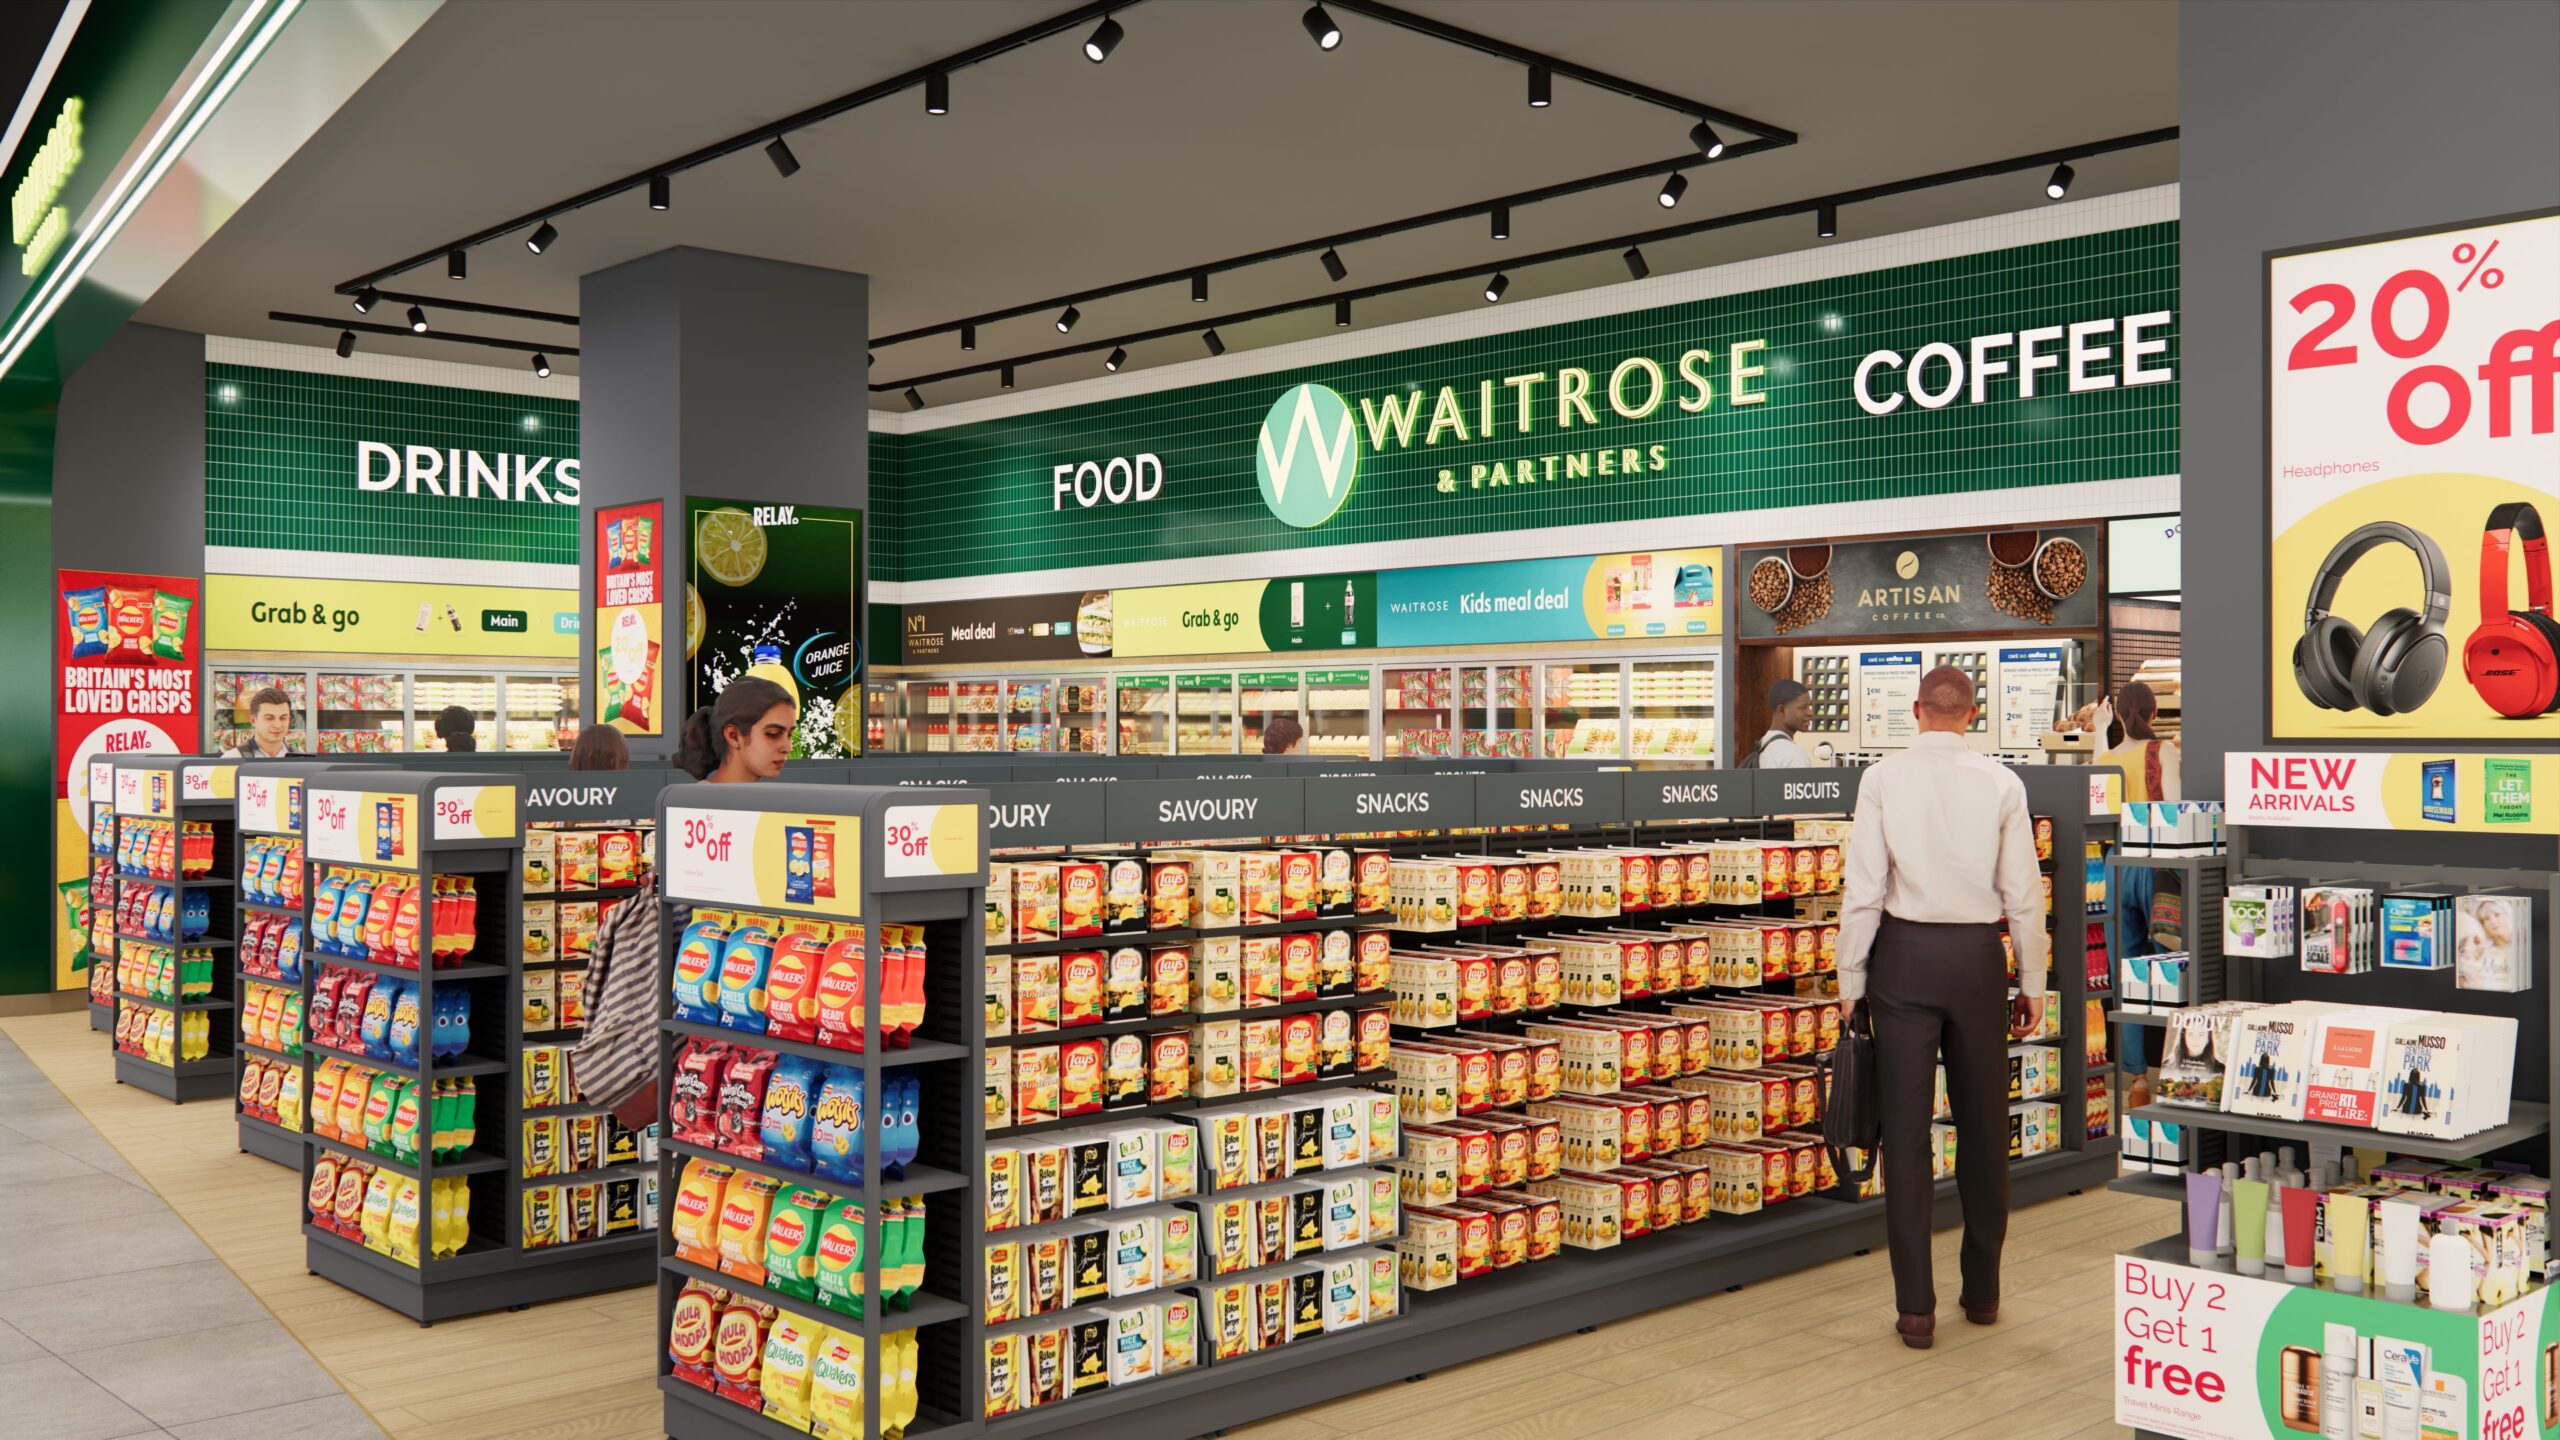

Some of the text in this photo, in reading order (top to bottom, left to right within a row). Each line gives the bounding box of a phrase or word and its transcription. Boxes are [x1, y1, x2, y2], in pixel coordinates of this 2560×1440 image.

[2288, 239, 2504, 371] 20%
[1853, 310, 2173, 415] COFFEE
[1360, 339, 1768, 451] WAITROSE
[358, 440, 580, 506] DRINKS
[1436, 445, 1668, 493] & PARTNERS
[2283, 461, 2380, 479] Headphones
[1053, 453, 1164, 510] FOOD
[606, 571, 653, 590] BRITAIN'S MOST
[606, 587, 653, 606] LOVED CRISPS
[1460, 586, 1568, 614] Kids meal deal
[1858, 585, 1960, 607] ARTISAN
[1390, 600, 1449, 614] WAITROSE
[1872, 612, 1931, 621] COFFEE
[118, 614, 144, 624] WALKERS
[251, 602, 360, 632] Grab & go
[490, 615, 519, 628] Main
[1182, 609, 1239, 631] Grab & go
[952, 622, 996, 641] Meal deal
[908, 637, 944, 647] WAITROSE
[805, 642, 850, 664] ORANGE
[65, 667, 192, 690] BRITAIN'S MOST
[811, 660, 843, 678] JUICE
[2481, 669, 2522, 677] BOSE
[65, 689, 192, 714] LOVED CRISPS
[2251, 758, 2357, 790] NEW
[1662, 784, 1719, 805] SNACKS
[1784, 782, 1840, 800] BISCUITS
[2499, 780, 2524, 791] LET
[525, 787, 618, 807] AVOURY
[1357, 792, 1430, 815] SNACKS
[1520, 787, 1584, 809] SNACKS
[2249, 794, 2355, 812] ARRIVALS
[2490, 792, 2530, 804] THEM
[1159, 798, 1258, 823] SAVOURY
[707, 832, 731, 862] off
[902, 836, 928, 857] off
[680, 955, 709, 969] WALKERS
[2307, 952, 2329, 964] SCALE
[725, 961, 755, 975] WALKERS
[771, 969, 804, 984] WALKERS
[821, 977, 857, 993] WALKERS
[771, 1000, 792, 1010] READY
[821, 1009, 844, 1020] READY
[2257, 1032, 2280, 1041] CENTRAL
[2269, 1021, 2294, 1035] MUSSO
[2255, 1040, 2280, 1056] PARK
[2405, 1046, 2431, 1056] CENTRAL
[2418, 1034, 2446, 1050] MUSSO
[2403, 1055, 2431, 1072] PARK
[2309, 1090, 2339, 1101] GRAND
[2319, 1100, 2338, 1109] PRIX
[2339, 1093, 2358, 1109] RTL
[1121, 1161, 1137, 1169] RICE
[678, 1194, 709, 1213] WALKERS
[723, 1208, 754, 1226] WALKERS
[770, 1222, 804, 1243] WALKERS
[821, 1237, 856, 1258] WALKERS
[1121, 1249, 1137, 1258] RICE
[2126, 1262, 2226, 1312] Buy 2
[676, 1305, 700, 1328] HULA
[674, 1321, 707, 1347] HOOPS
[721, 1323, 747, 1345] HULA
[2124, 1307, 2217, 1353] Get 1
[2484, 1311, 2525, 1355] Buy 2
[718, 1340, 754, 1366] HOOPS
[2384, 1350, 2419, 1365] CeraVe
[2124, 1345, 2226, 1403] free
[2483, 1360, 2522, 1402] Get 1
[2123, 1396, 2202, 1421] Travel Minis Range
[2483, 1405, 2525, 1440] free
